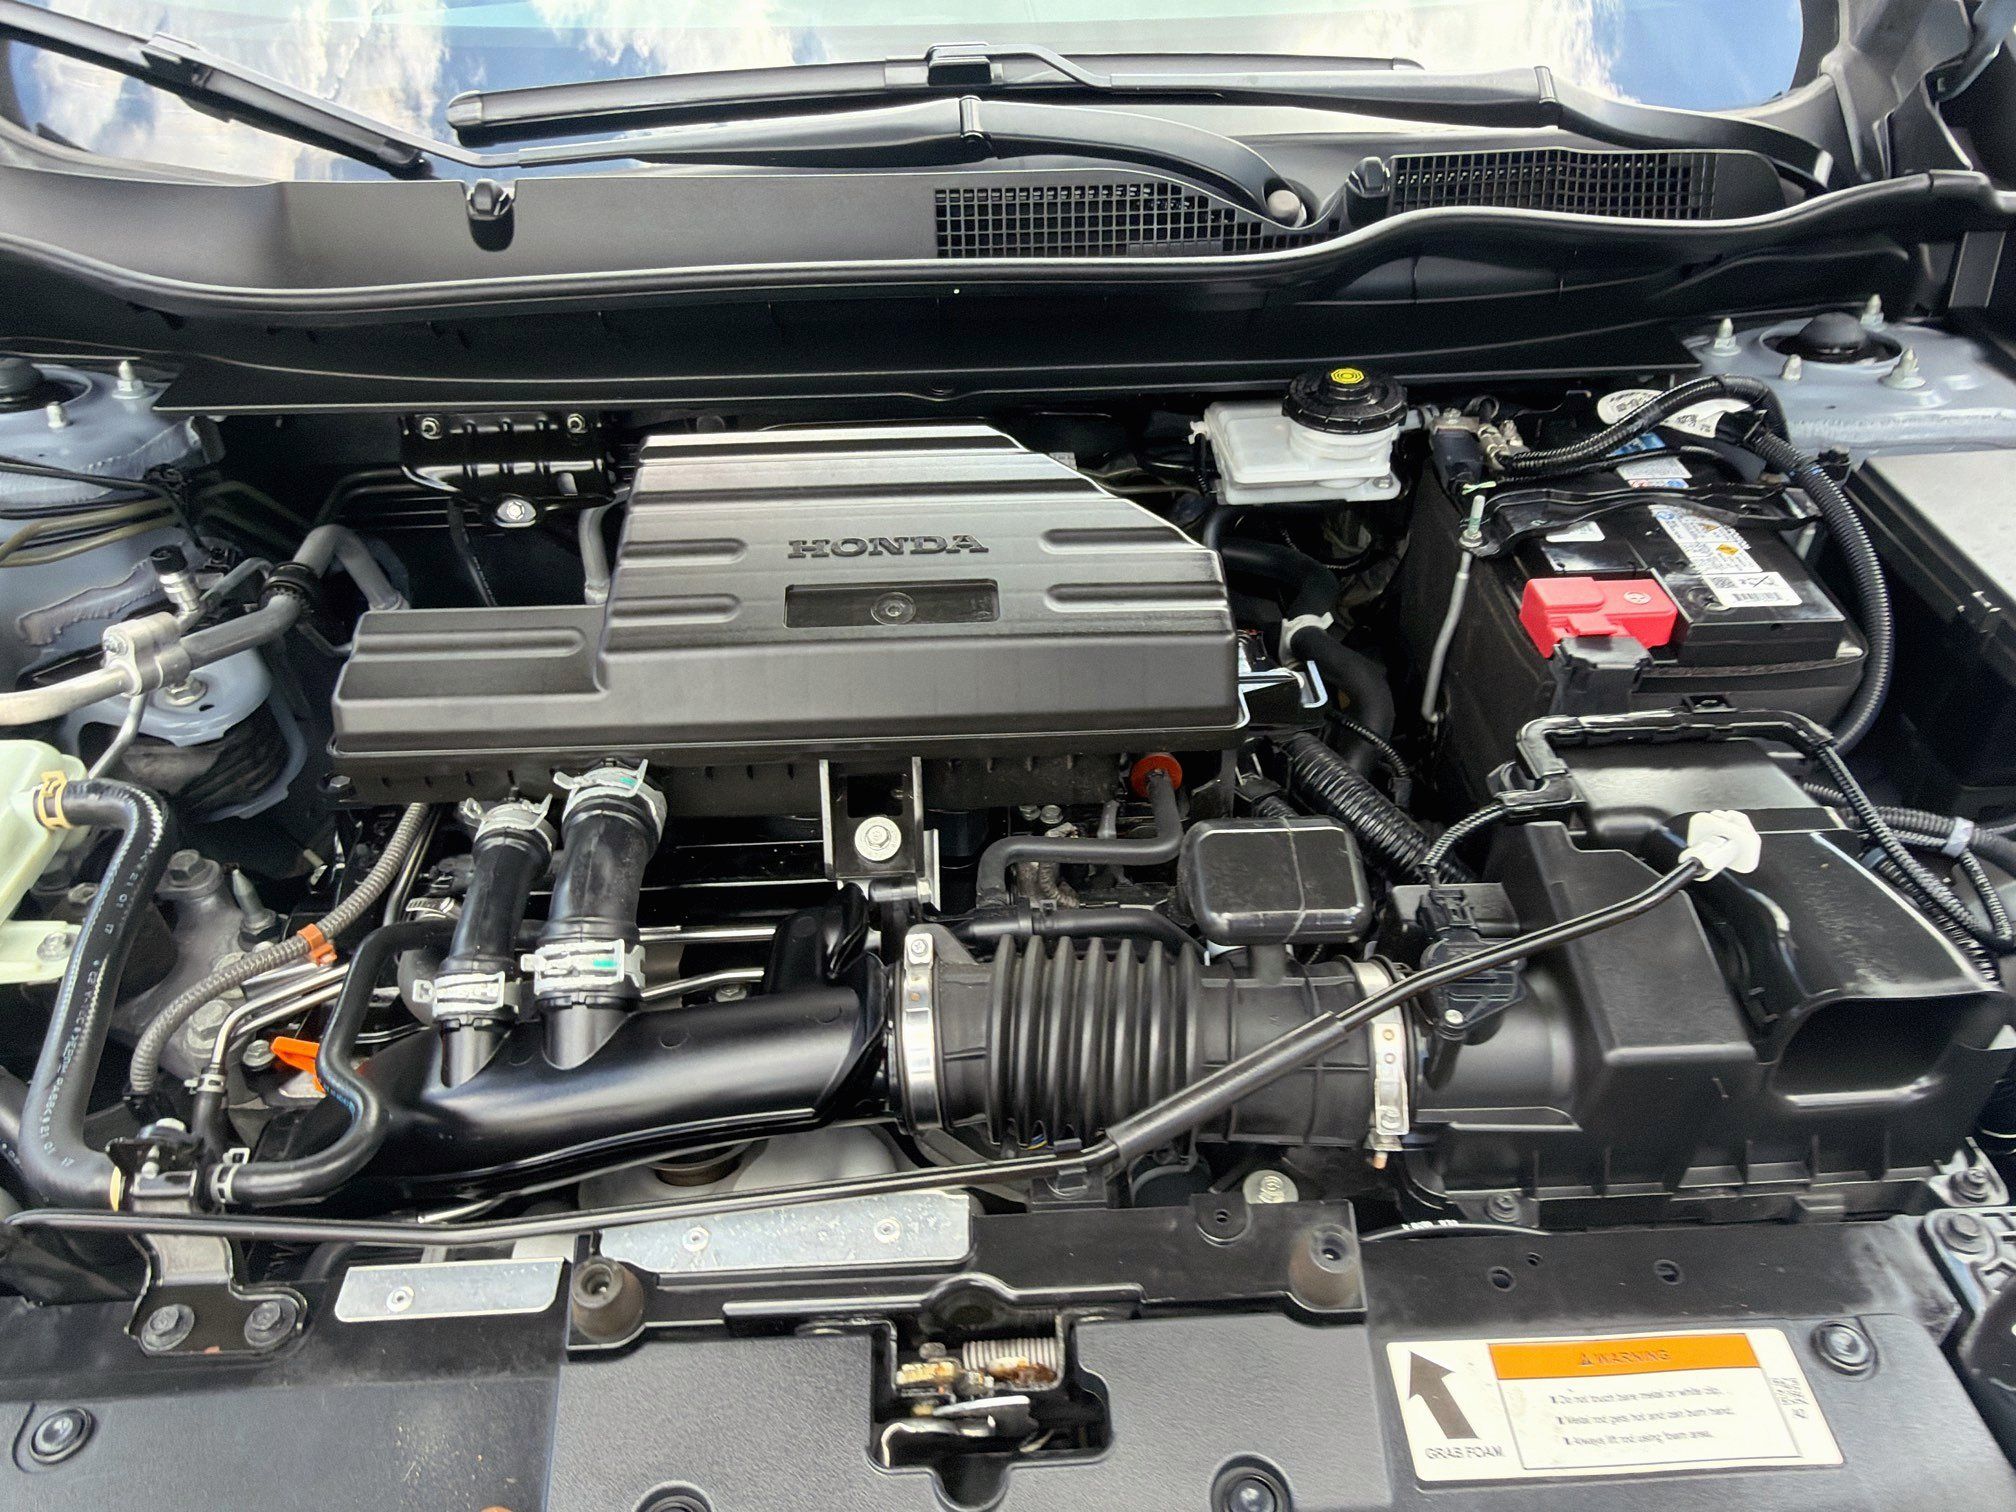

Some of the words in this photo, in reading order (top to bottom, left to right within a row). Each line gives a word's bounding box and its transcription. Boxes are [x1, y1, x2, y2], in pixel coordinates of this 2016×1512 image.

[788, 534, 989, 559] HONDA
[1593, 1349, 1672, 1364] WARNING
[1424, 1446, 1464, 1460] GRAB
[1464, 1445, 1505, 1459] FOAM
